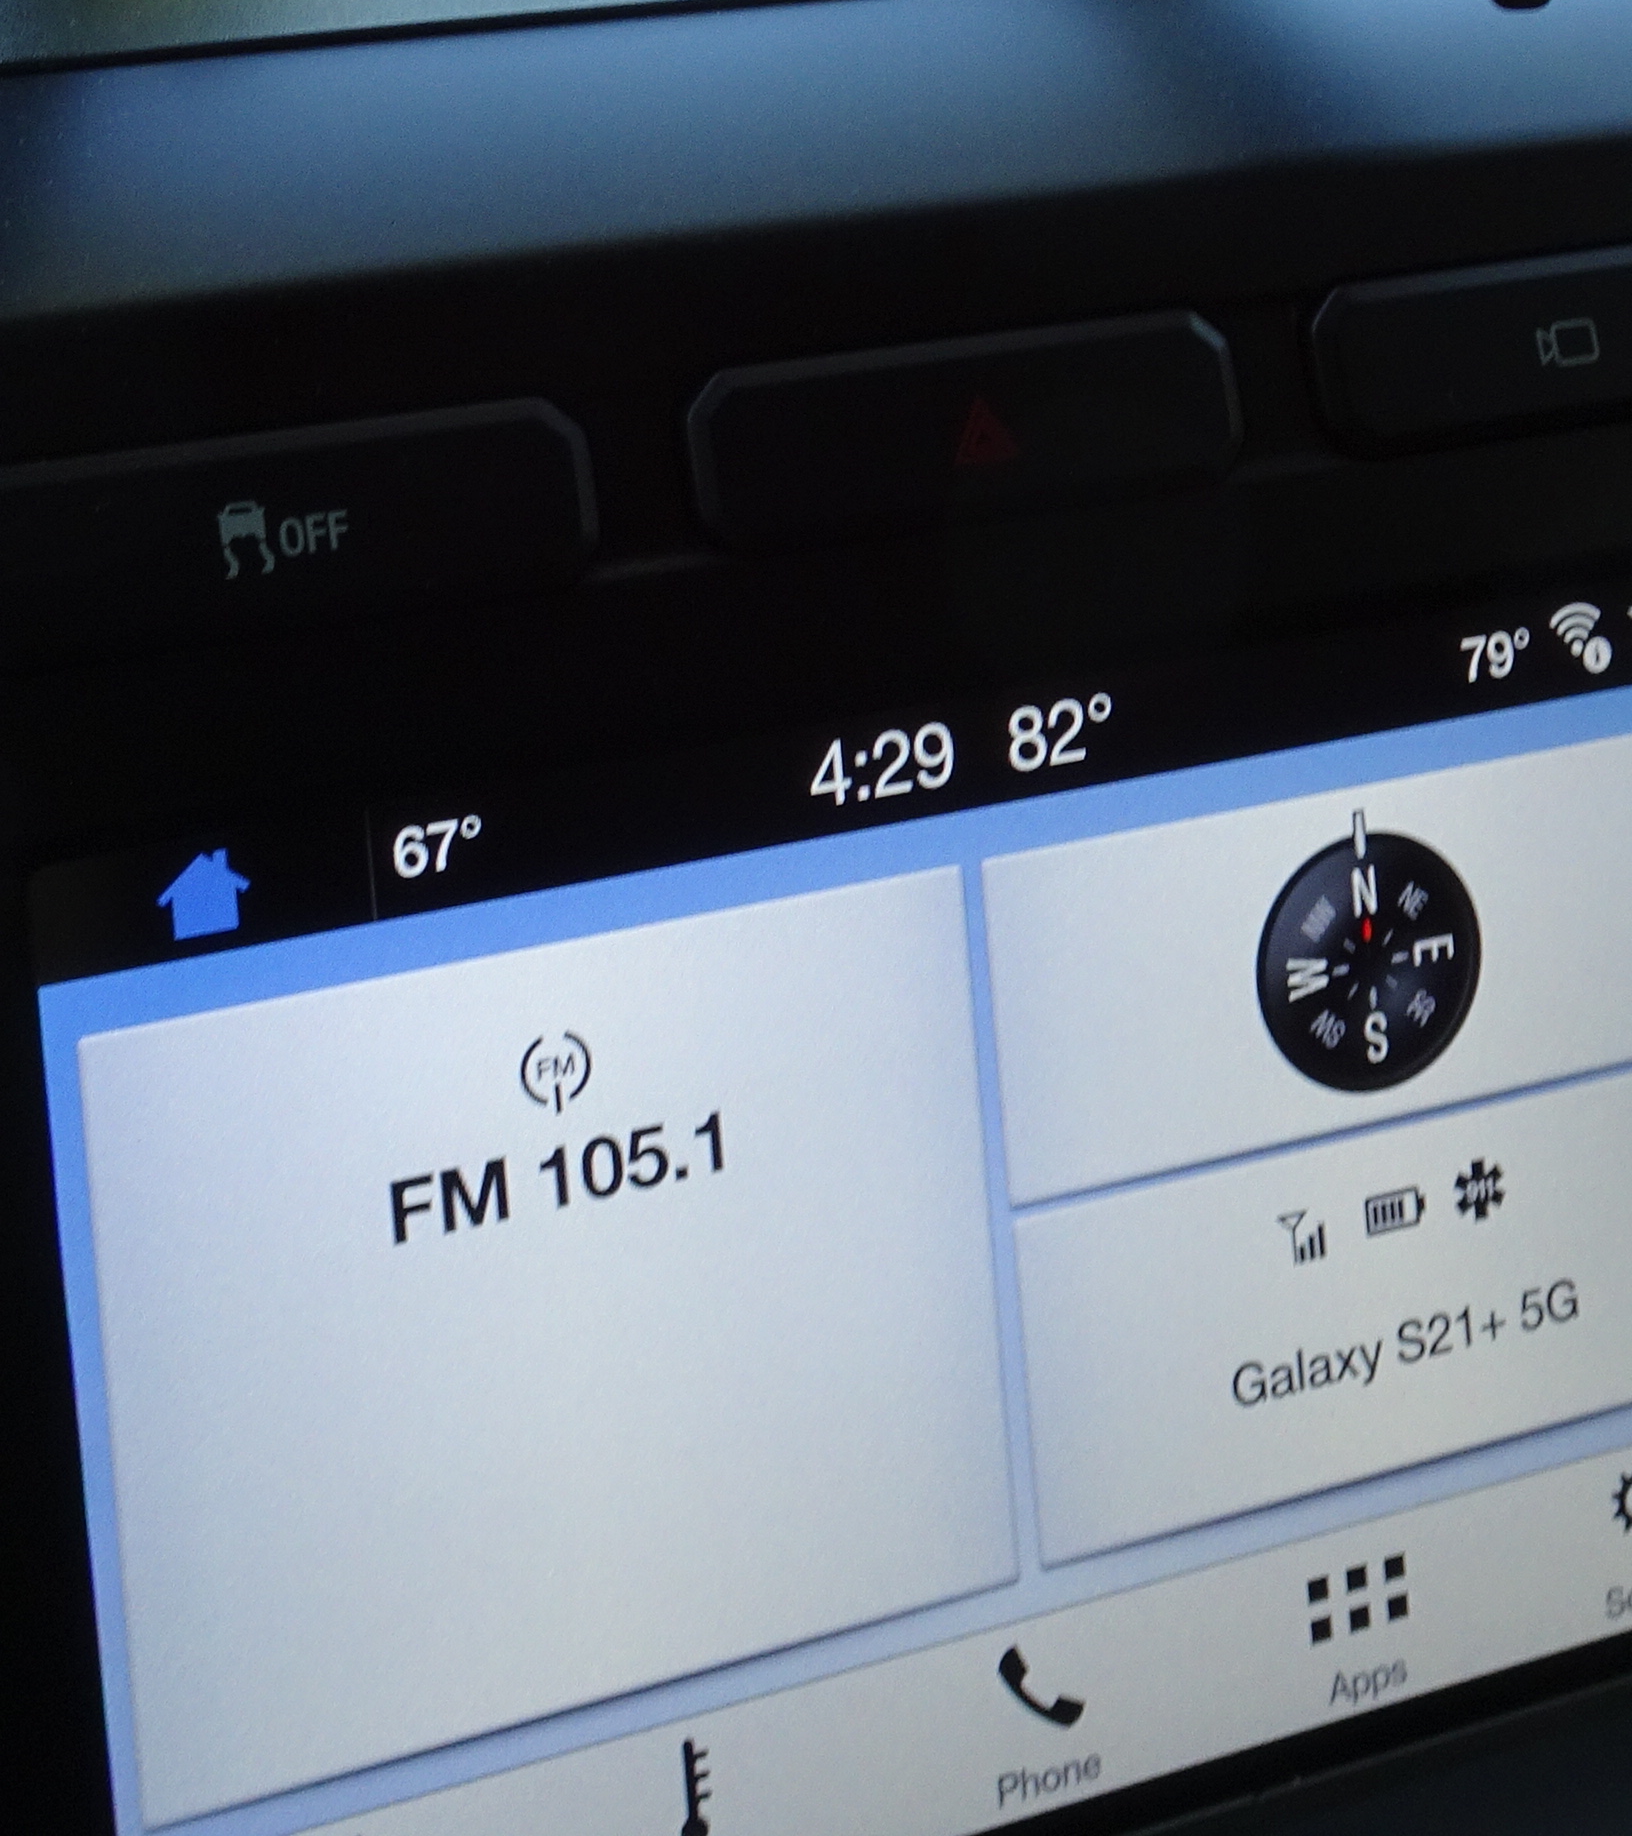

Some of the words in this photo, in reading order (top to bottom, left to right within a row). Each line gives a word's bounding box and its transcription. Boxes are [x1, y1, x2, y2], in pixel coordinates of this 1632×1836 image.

[279, 509, 349, 558] OFF
[1460, 627, 1530, 684] 79°
[809, 721, 955, 807] 4:29
[1008, 692, 1112, 773] 82°
[393, 814, 482, 879] 67°
[1350, 864, 1378, 918] N
[1413, 932, 1455, 967] E
[1364, 1011, 1389, 1064] S
[536, 1052, 575, 1081] FM
[390, 1155, 510, 1246] FM
[539, 1109, 725, 1210] 105.1
[1232, 1338, 1383, 1408] Galaxy
[1396, 1304, 1506, 1366] S21+
[1520, 1277, 1580, 1333] 5G
[1329, 1658, 1408, 1706] Apps
[996, 1751, 1102, 1808] Phone
